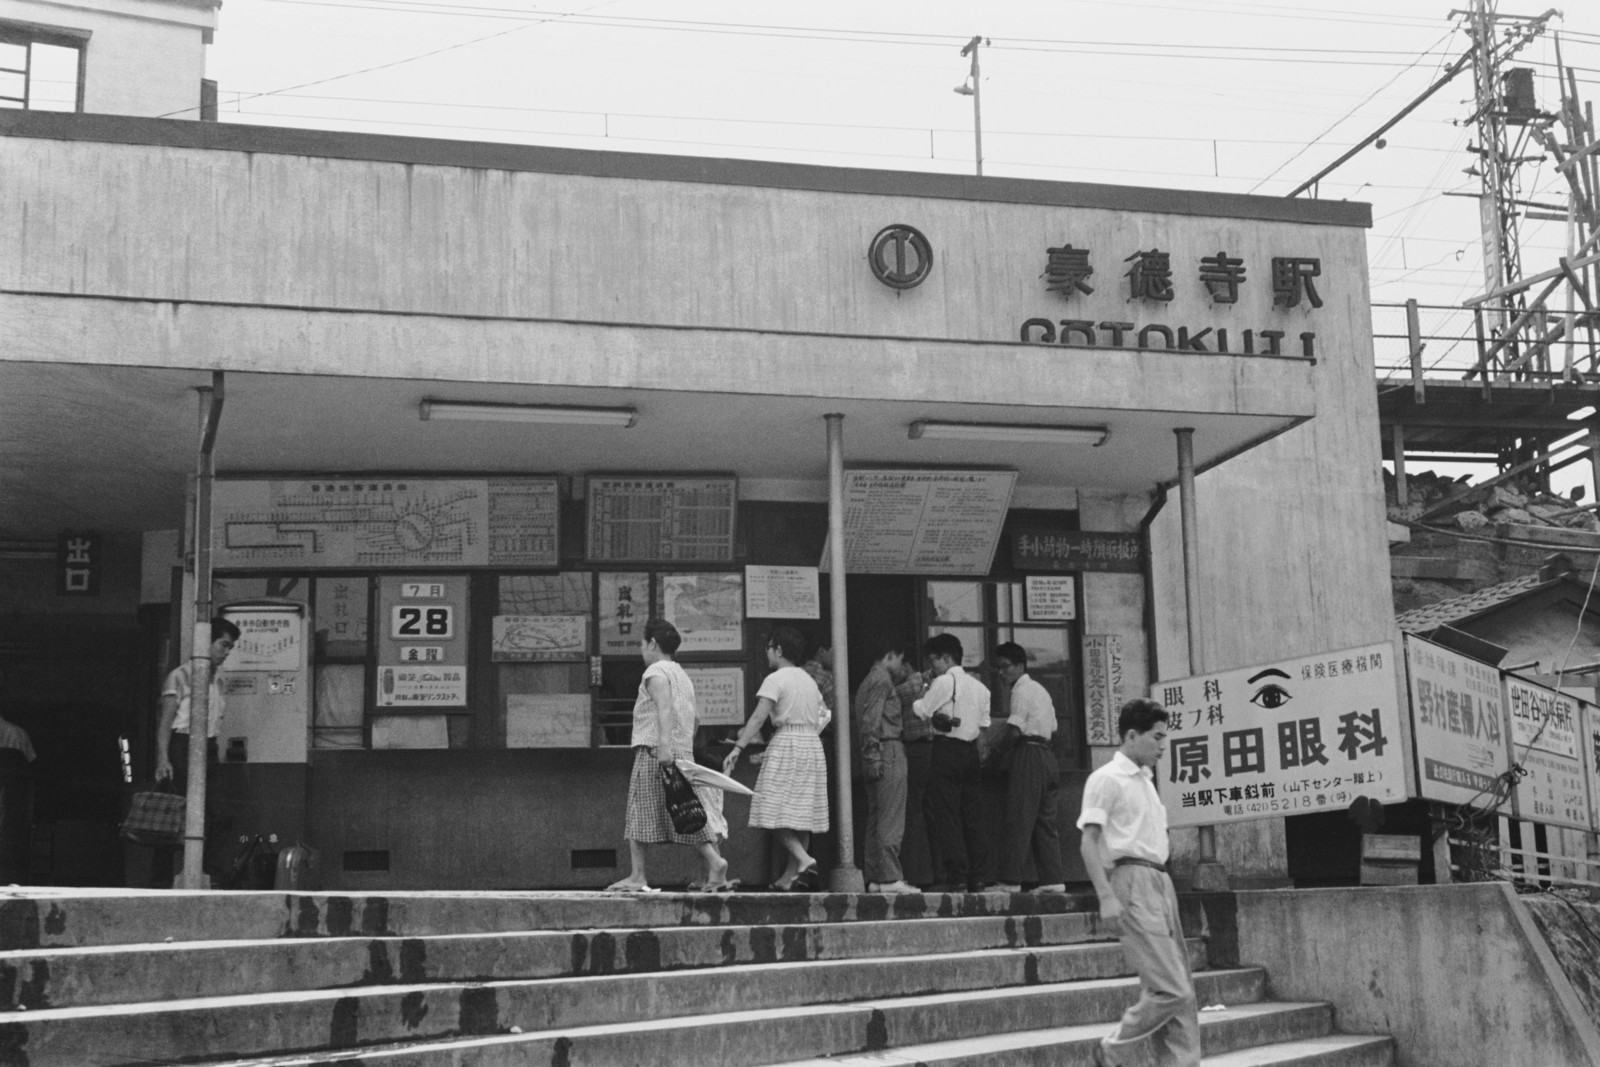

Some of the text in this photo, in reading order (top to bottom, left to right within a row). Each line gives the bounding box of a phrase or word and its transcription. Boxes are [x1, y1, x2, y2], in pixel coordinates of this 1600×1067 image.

[65, 537, 92, 591] 出口
[408, 584, 442, 598] 7月
[399, 608, 448, 635] 28
[407, 648, 438, 661] 金曜
[1301, 653, 1383, 681] 保険医療機関
[1163, 679, 1222, 707] 眼科
[1169, 708, 1388, 784] 原田眼科
